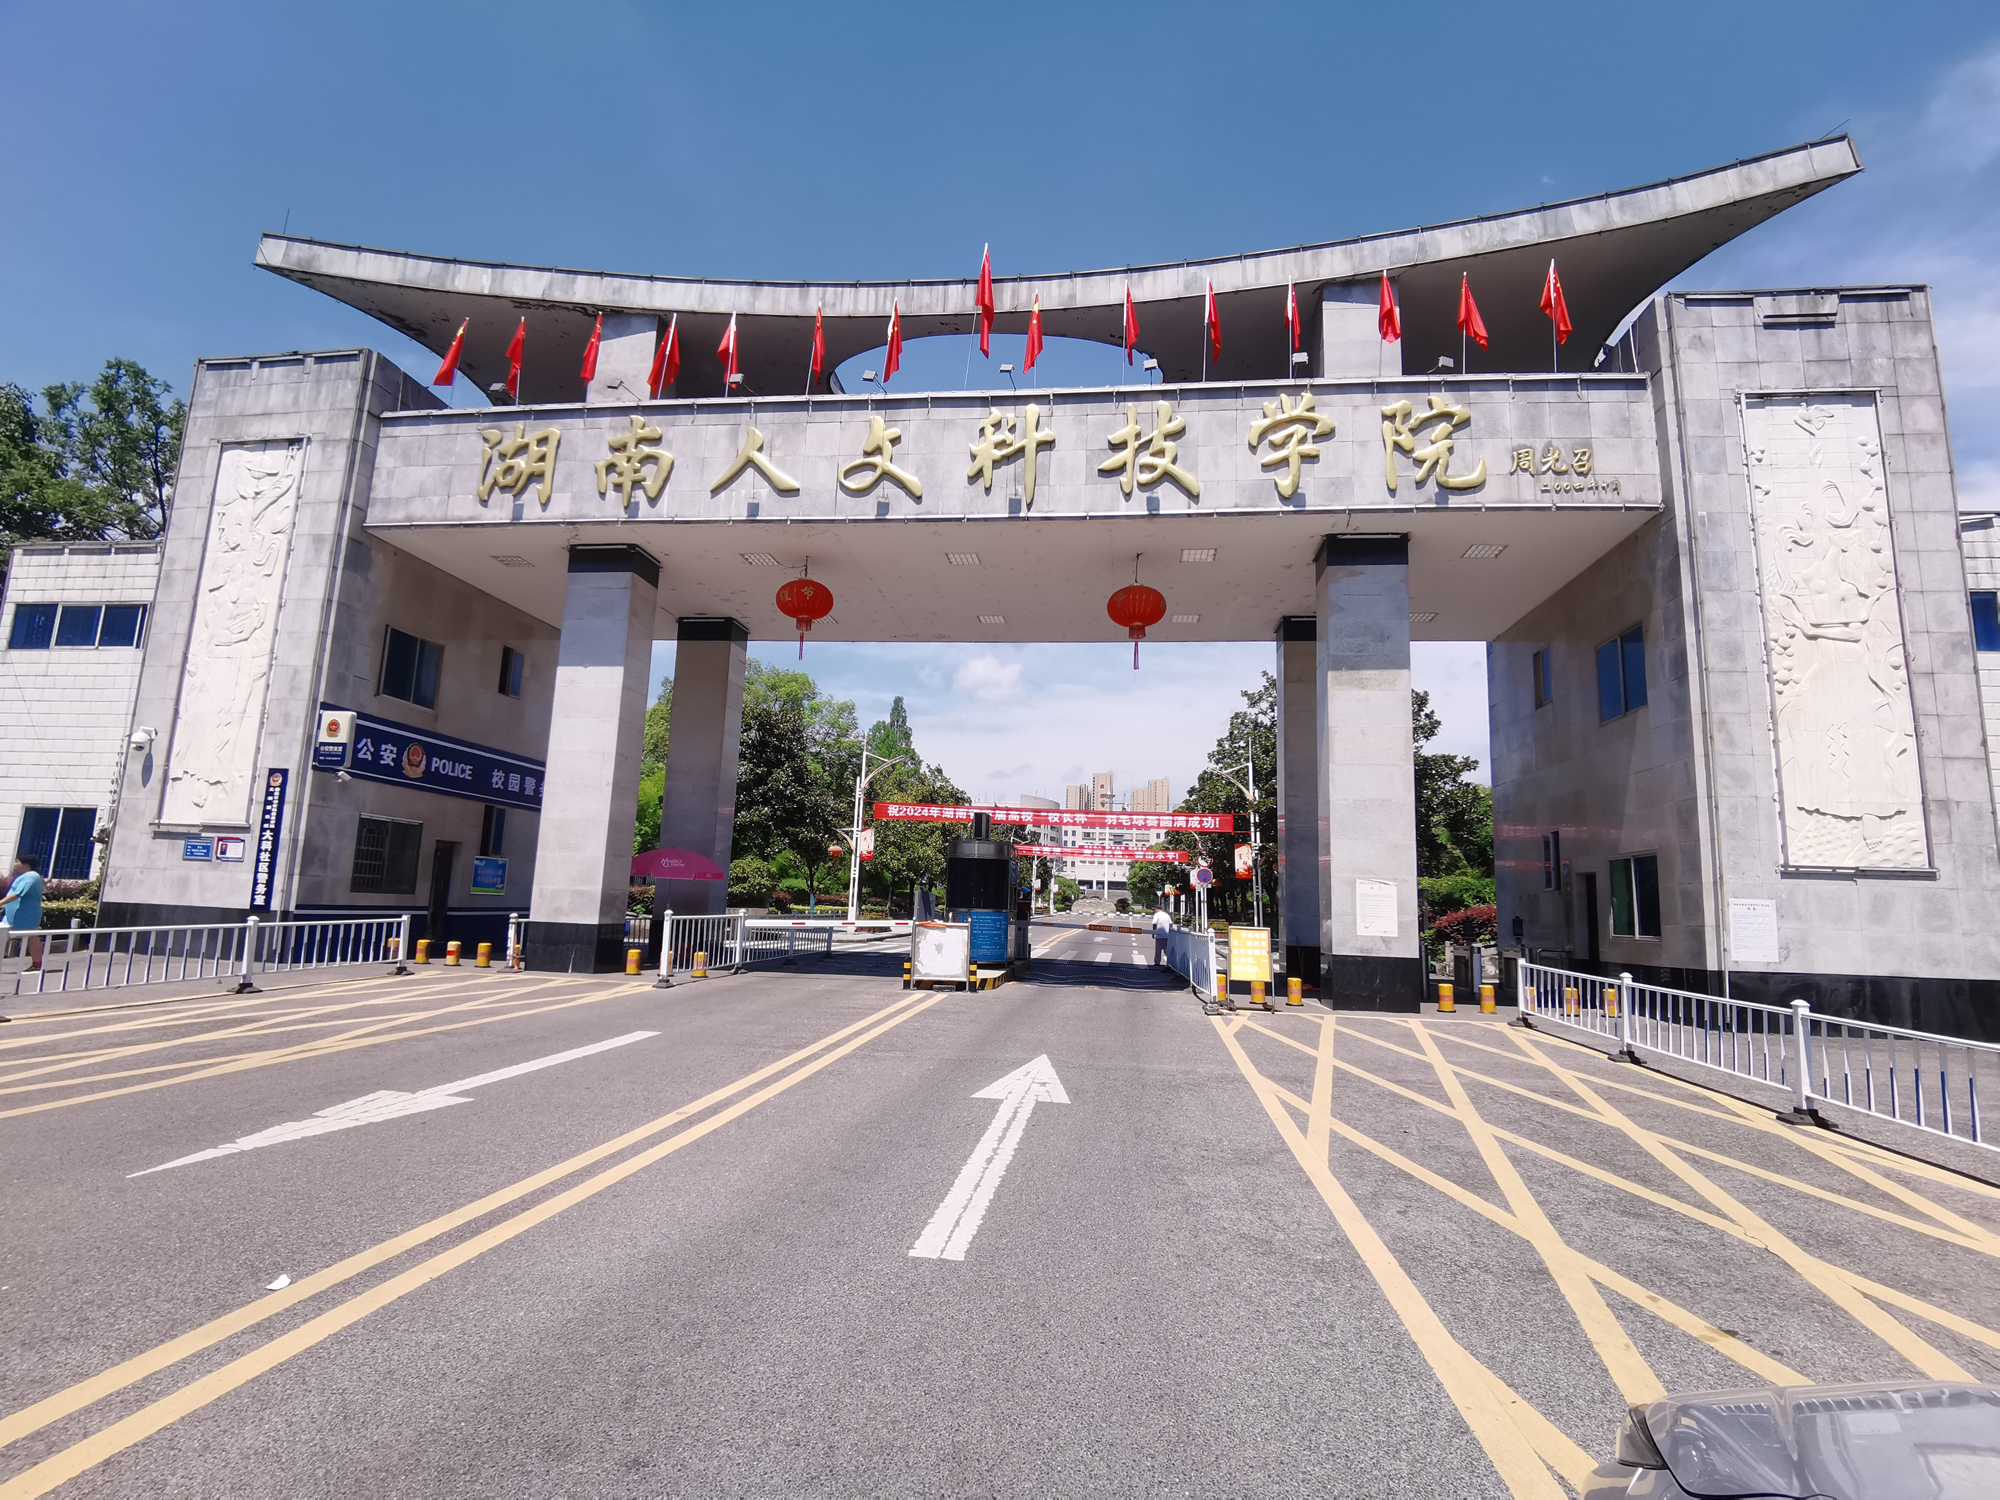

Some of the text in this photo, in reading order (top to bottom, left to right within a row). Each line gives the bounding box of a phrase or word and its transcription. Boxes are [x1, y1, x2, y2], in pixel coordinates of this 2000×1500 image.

[477, 391, 1487, 508] 湖南人文科技学院
[1510, 446, 1594, 477] 周光召
[356, 737, 546, 797] 公安 POLICE 校园警
[253, 830, 274, 906] 大科社区警务室
